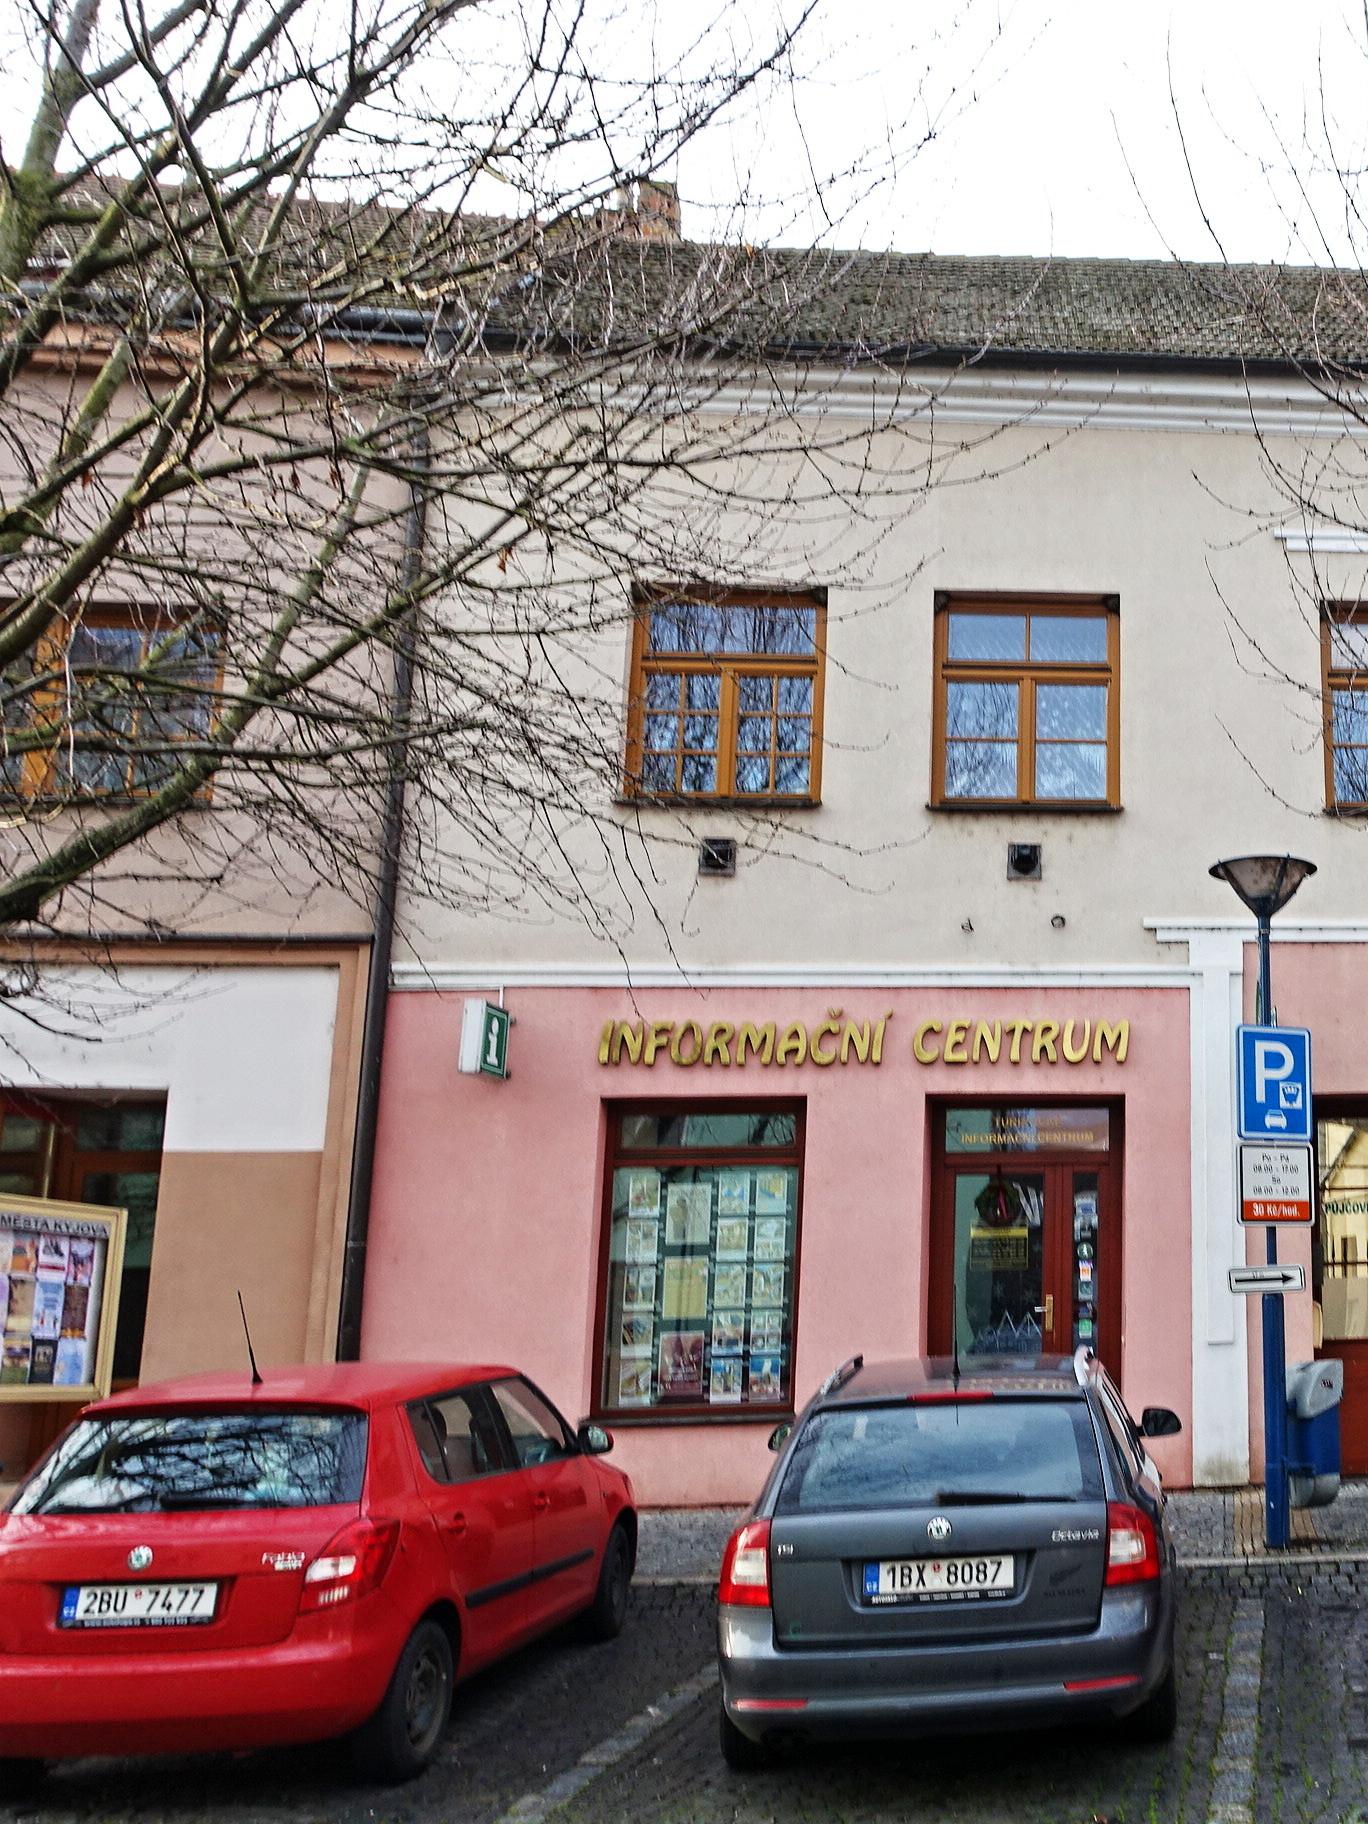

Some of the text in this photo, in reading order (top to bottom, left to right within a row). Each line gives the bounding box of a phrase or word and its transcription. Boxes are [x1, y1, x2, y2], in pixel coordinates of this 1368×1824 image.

[597, 1008, 1131, 1067] INFORMAČNÍ CENTRUM
[1254, 1039, 1295, 1104] P
[887, 1563, 927, 1589] 1BX
[946, 1560, 1003, 1586] 8087
[83, 1588, 128, 1614] 2BU
[146, 1586, 206, 1614] 7477
